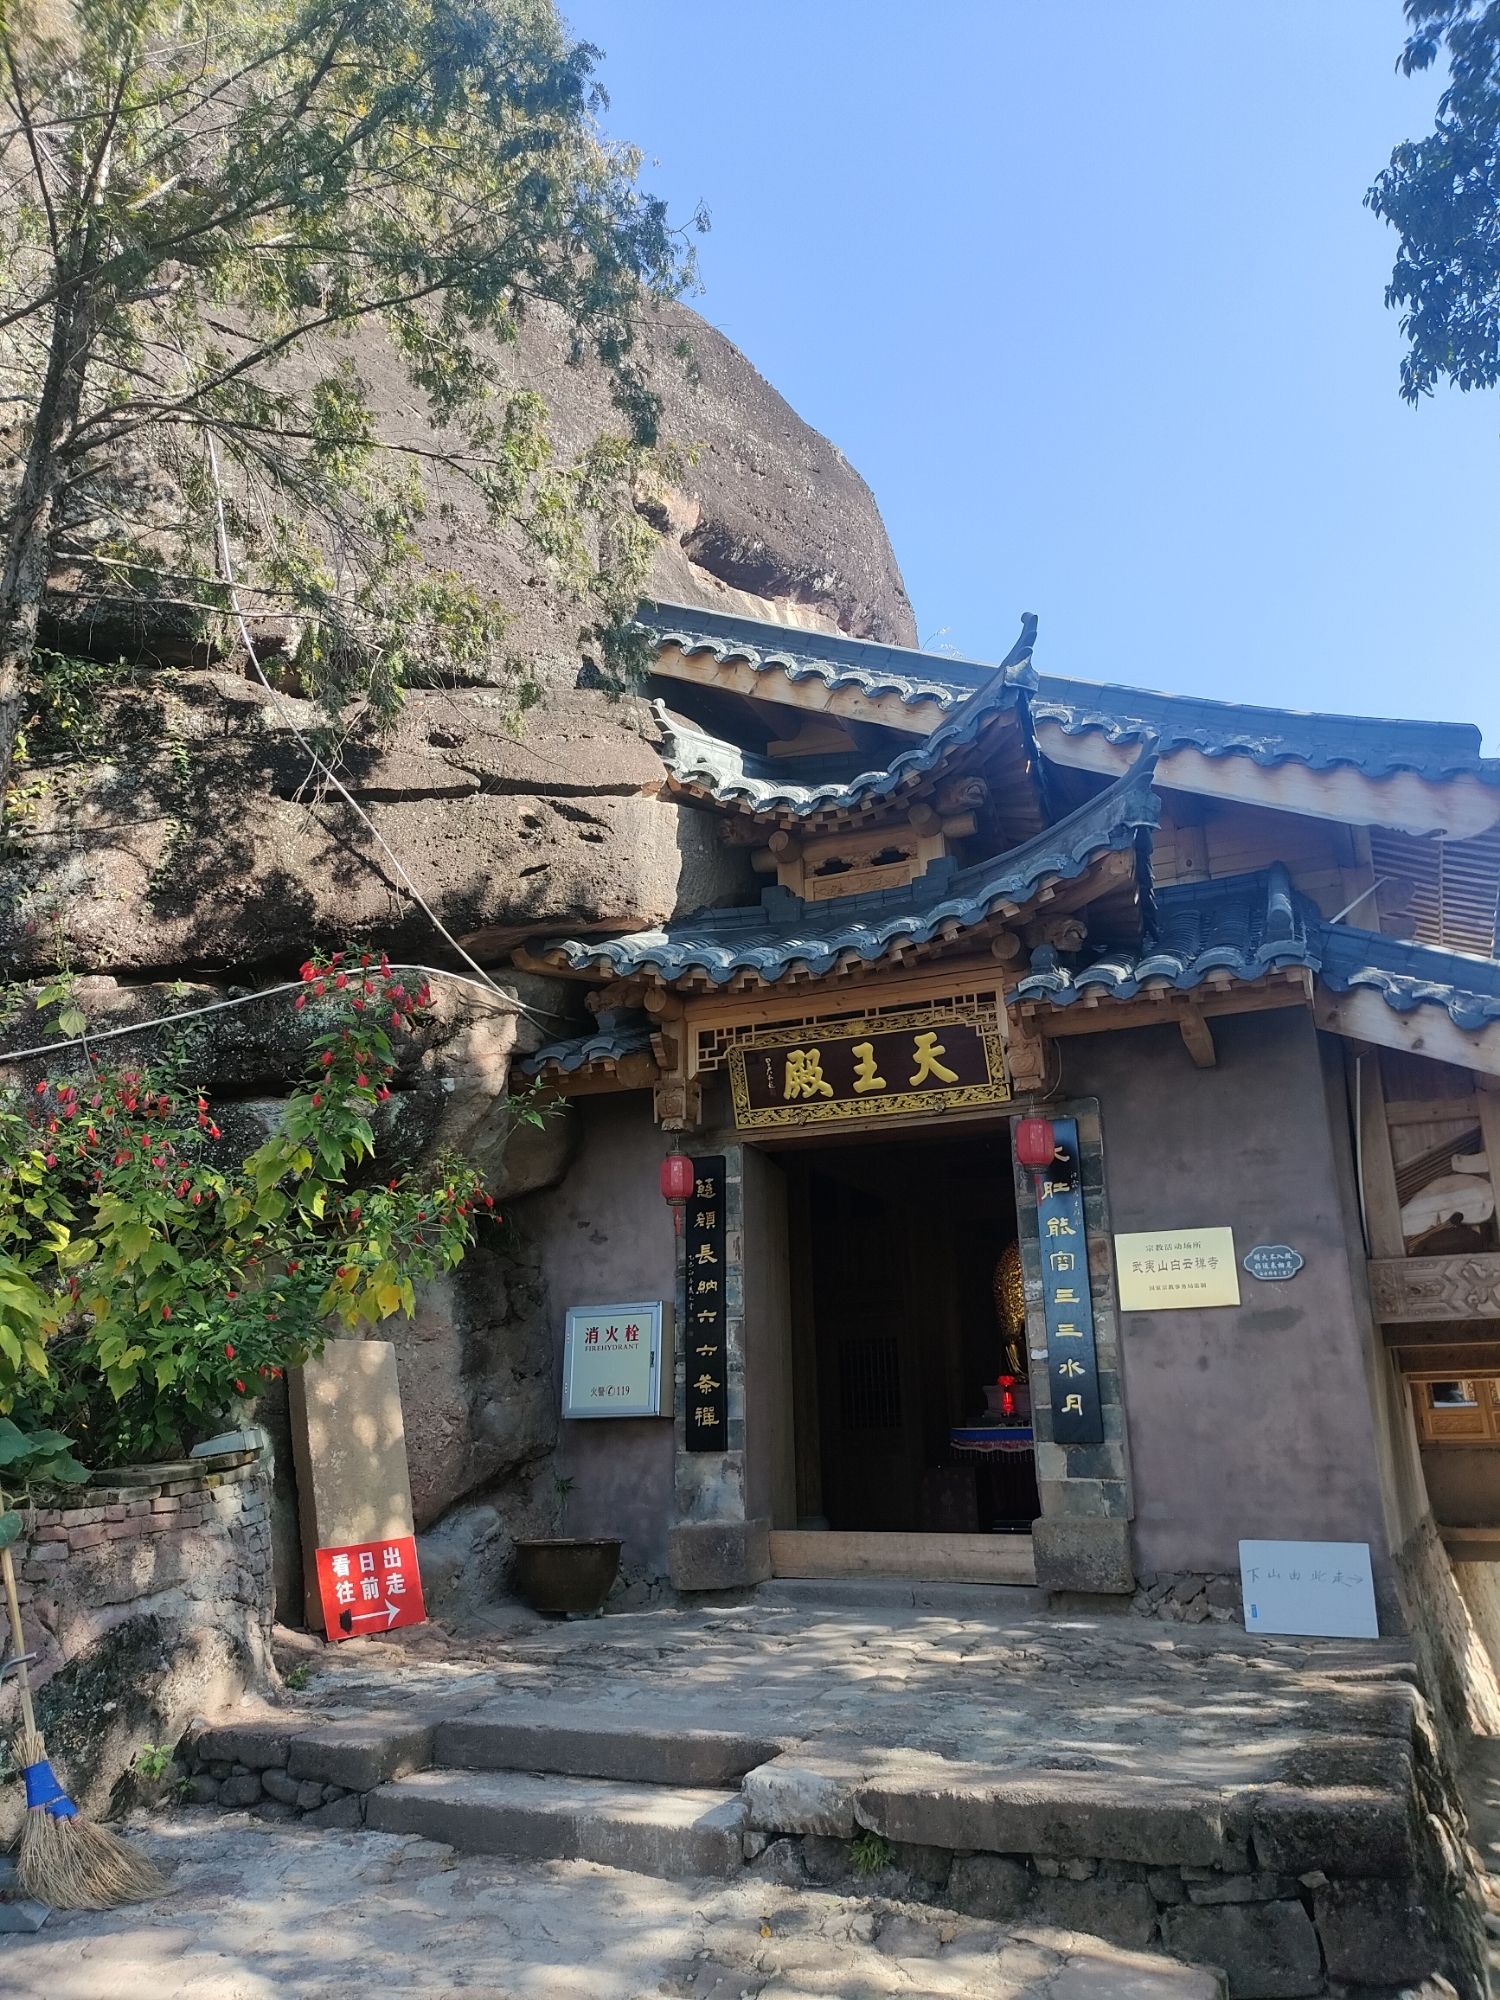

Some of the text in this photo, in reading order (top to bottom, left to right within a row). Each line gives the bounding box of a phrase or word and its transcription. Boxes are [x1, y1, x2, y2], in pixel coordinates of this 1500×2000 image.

[783, 1031, 959, 1100] 天王殿
[1145, 1241, 1202, 1252] 宗教活动场所
[1132, 1256, 1219, 1274] 武夷山白云禅寺
[584, 1324, 640, 1344] 消火栓
[590, 1385, 630, 1397] 火警 119
[331, 1546, 402, 1578] 看日出
[1247, 1567, 1353, 1588] 下山由此走
[335, 1572, 406, 1605] 往前走
